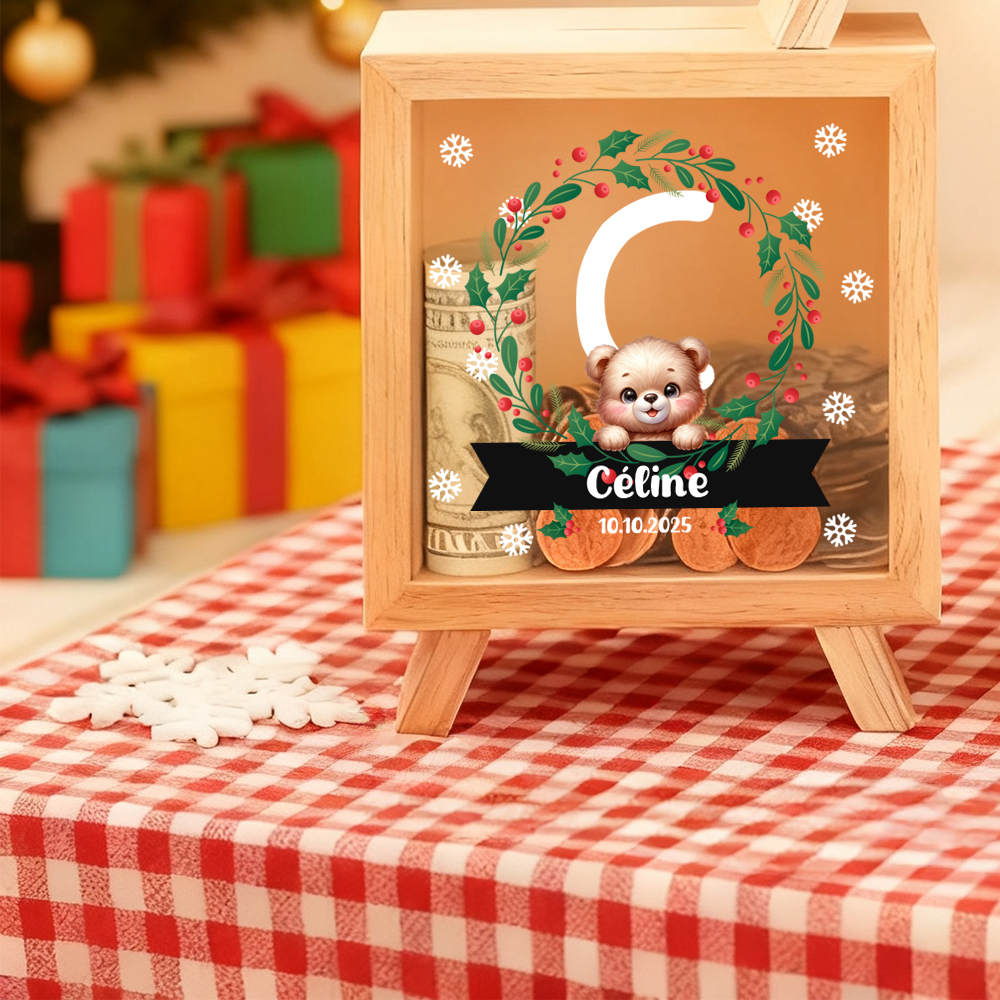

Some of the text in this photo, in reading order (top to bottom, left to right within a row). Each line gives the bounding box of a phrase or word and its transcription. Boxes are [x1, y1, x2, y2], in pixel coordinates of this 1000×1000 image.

[576, 189, 714, 391] C
[587, 466, 708, 500] Céline
[598, 517, 692, 534] 10.10.2025
